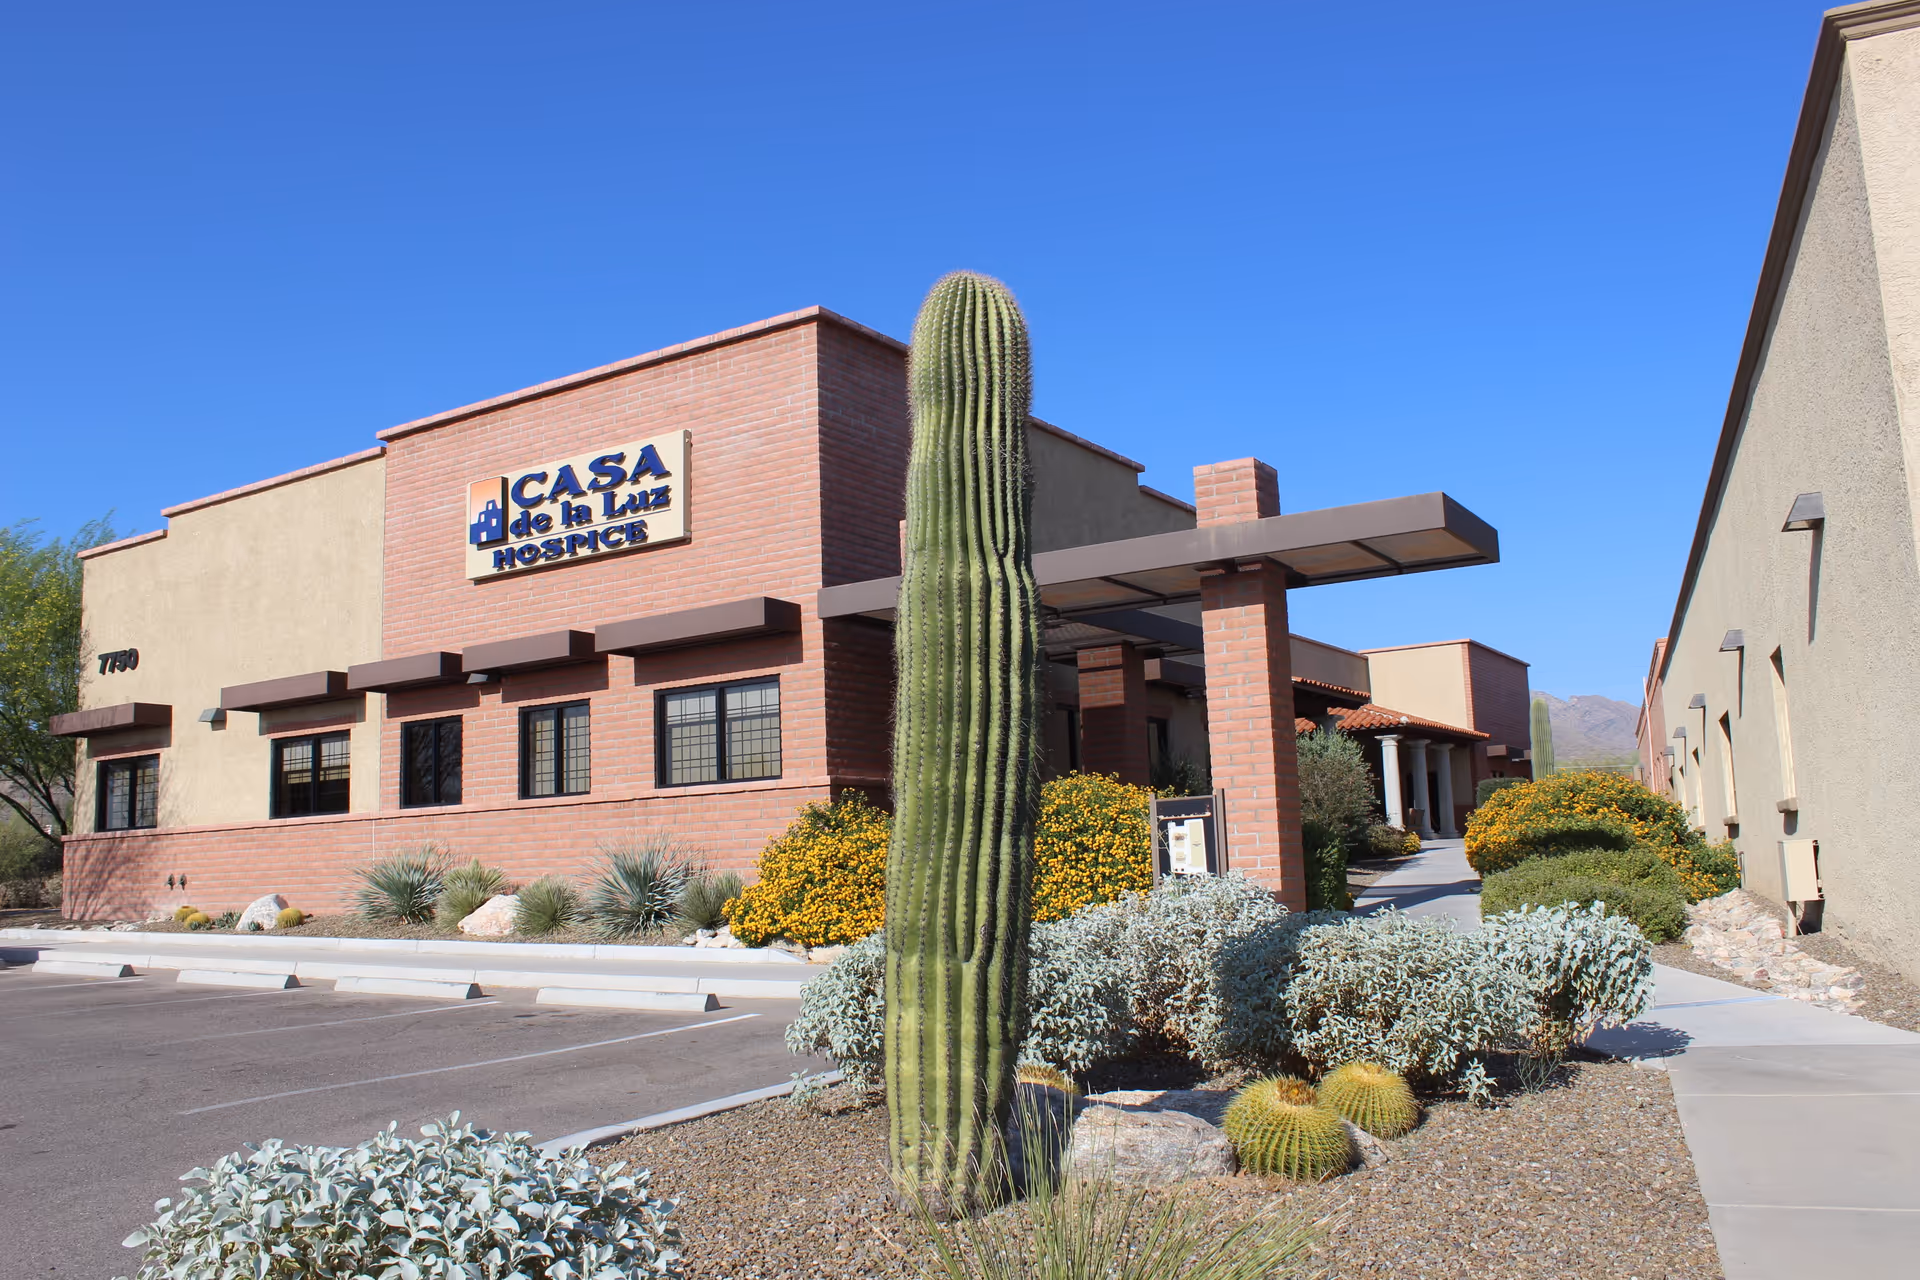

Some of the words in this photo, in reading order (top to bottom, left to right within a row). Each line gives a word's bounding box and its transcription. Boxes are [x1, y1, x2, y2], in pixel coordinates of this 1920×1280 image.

[510, 443, 671, 509] CASA
[509, 510, 551, 537] de
[560, 500, 592, 526] la
[602, 484, 671, 519] Luz
[492, 519, 648, 570] HOSPICE
[98, 647, 139, 675] 7750
